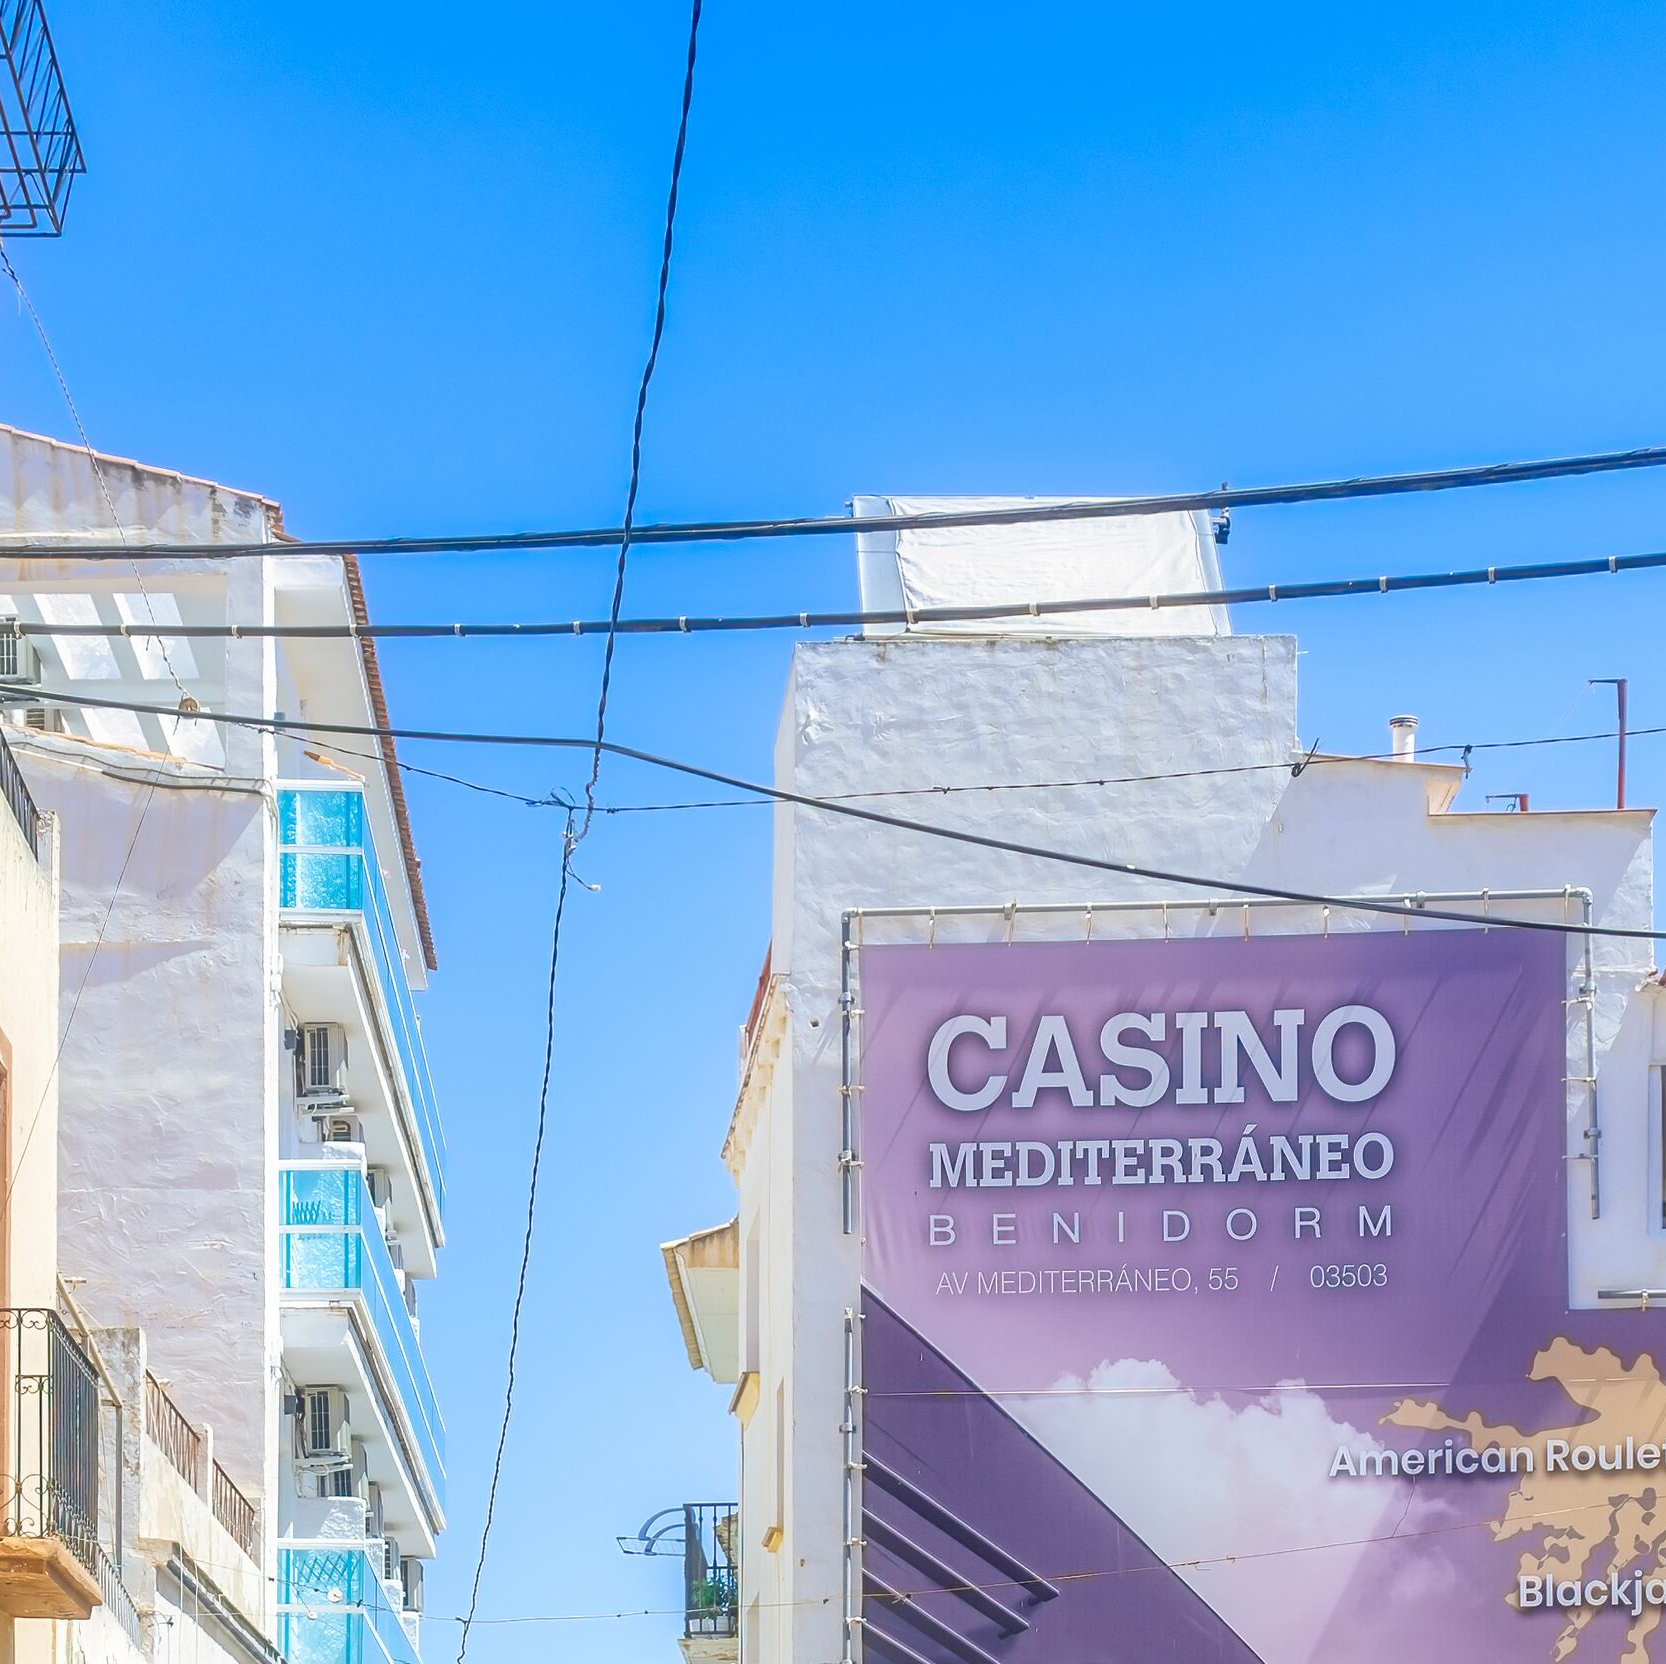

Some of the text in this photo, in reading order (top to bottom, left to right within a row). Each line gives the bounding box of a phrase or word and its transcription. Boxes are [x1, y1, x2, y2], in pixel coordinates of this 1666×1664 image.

[926, 1003, 1397, 1112] CASINO
[928, 1124, 1395, 1189] MEDITERRÁNEO
[928, 1204, 1393, 1247] BENIDORM
[935, 1271, 968, 1296] AV
[977, 1263, 1199, 1295] MEDITERRÁNEO,
[1208, 1267, 1239, 1291] 55
[1309, 1263, 1389, 1289] 03503
[1329, 1440, 1535, 1478] American
